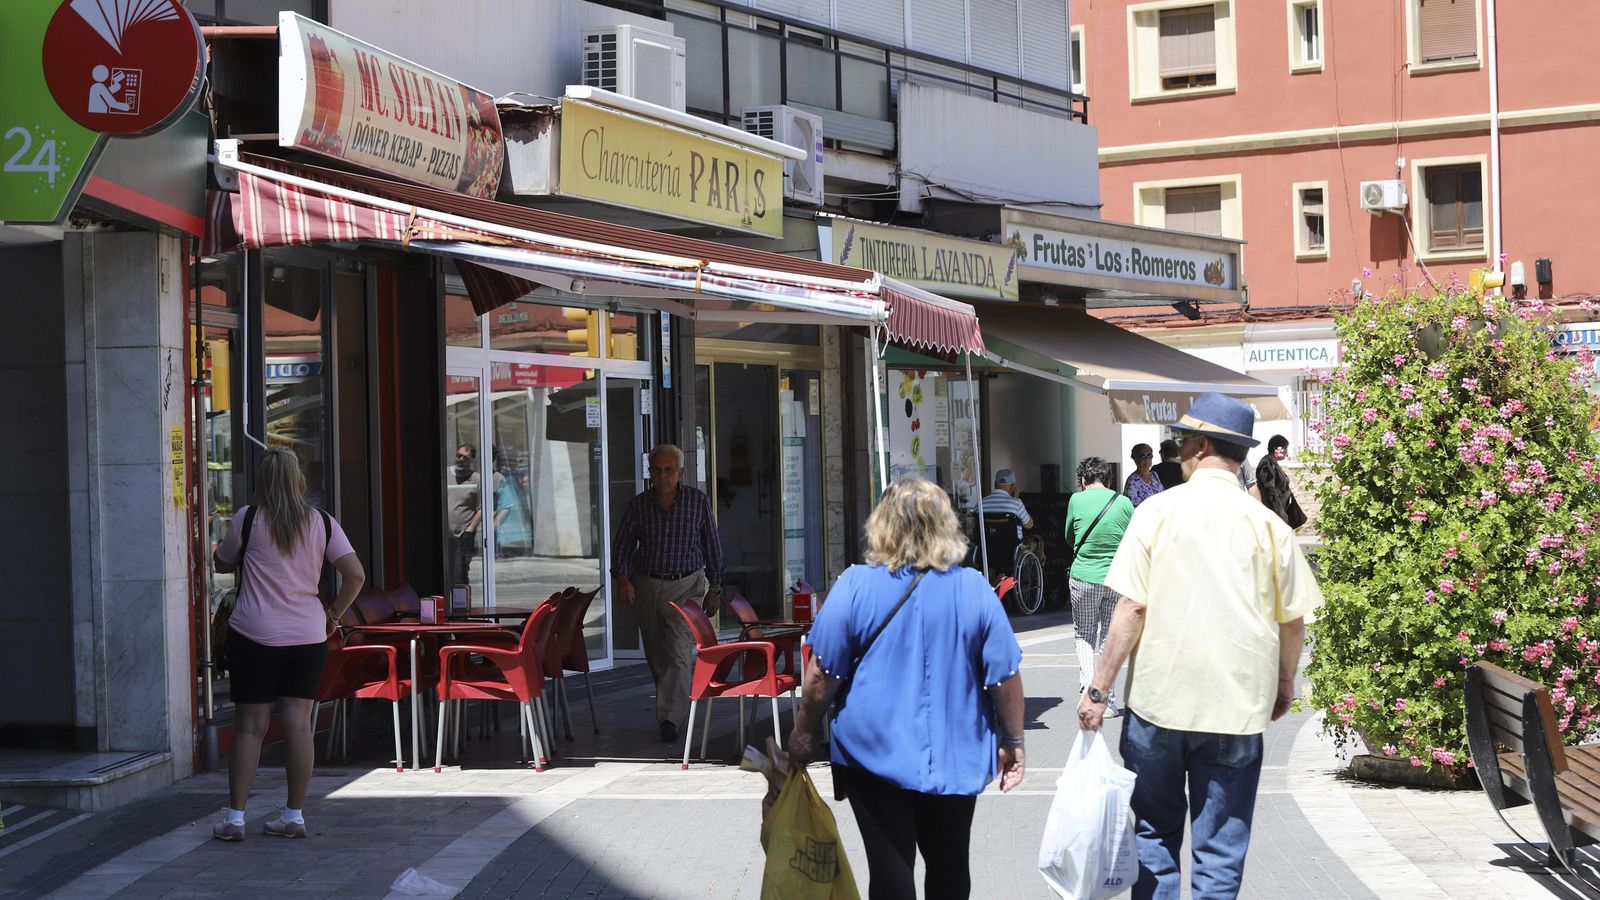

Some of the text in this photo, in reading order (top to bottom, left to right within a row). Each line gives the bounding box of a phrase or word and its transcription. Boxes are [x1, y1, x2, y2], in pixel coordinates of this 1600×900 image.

[387, 61, 462, 143] SULTAN
[3, 126, 61, 184] 24
[351, 116, 390, 161] DÖNER
[387, 133, 424, 169] KEBAP
[426, 146, 462, 181] PIZZAS
[581, 126, 682, 199] Charcutería
[859, 236, 998, 289] TINTORERIA LAVANDA
[1033, 232, 1197, 282] Frutas Los Romeros
[1249, 346, 1329, 363] AUTENTICA
[1142, 394, 1178, 422] Frutas
